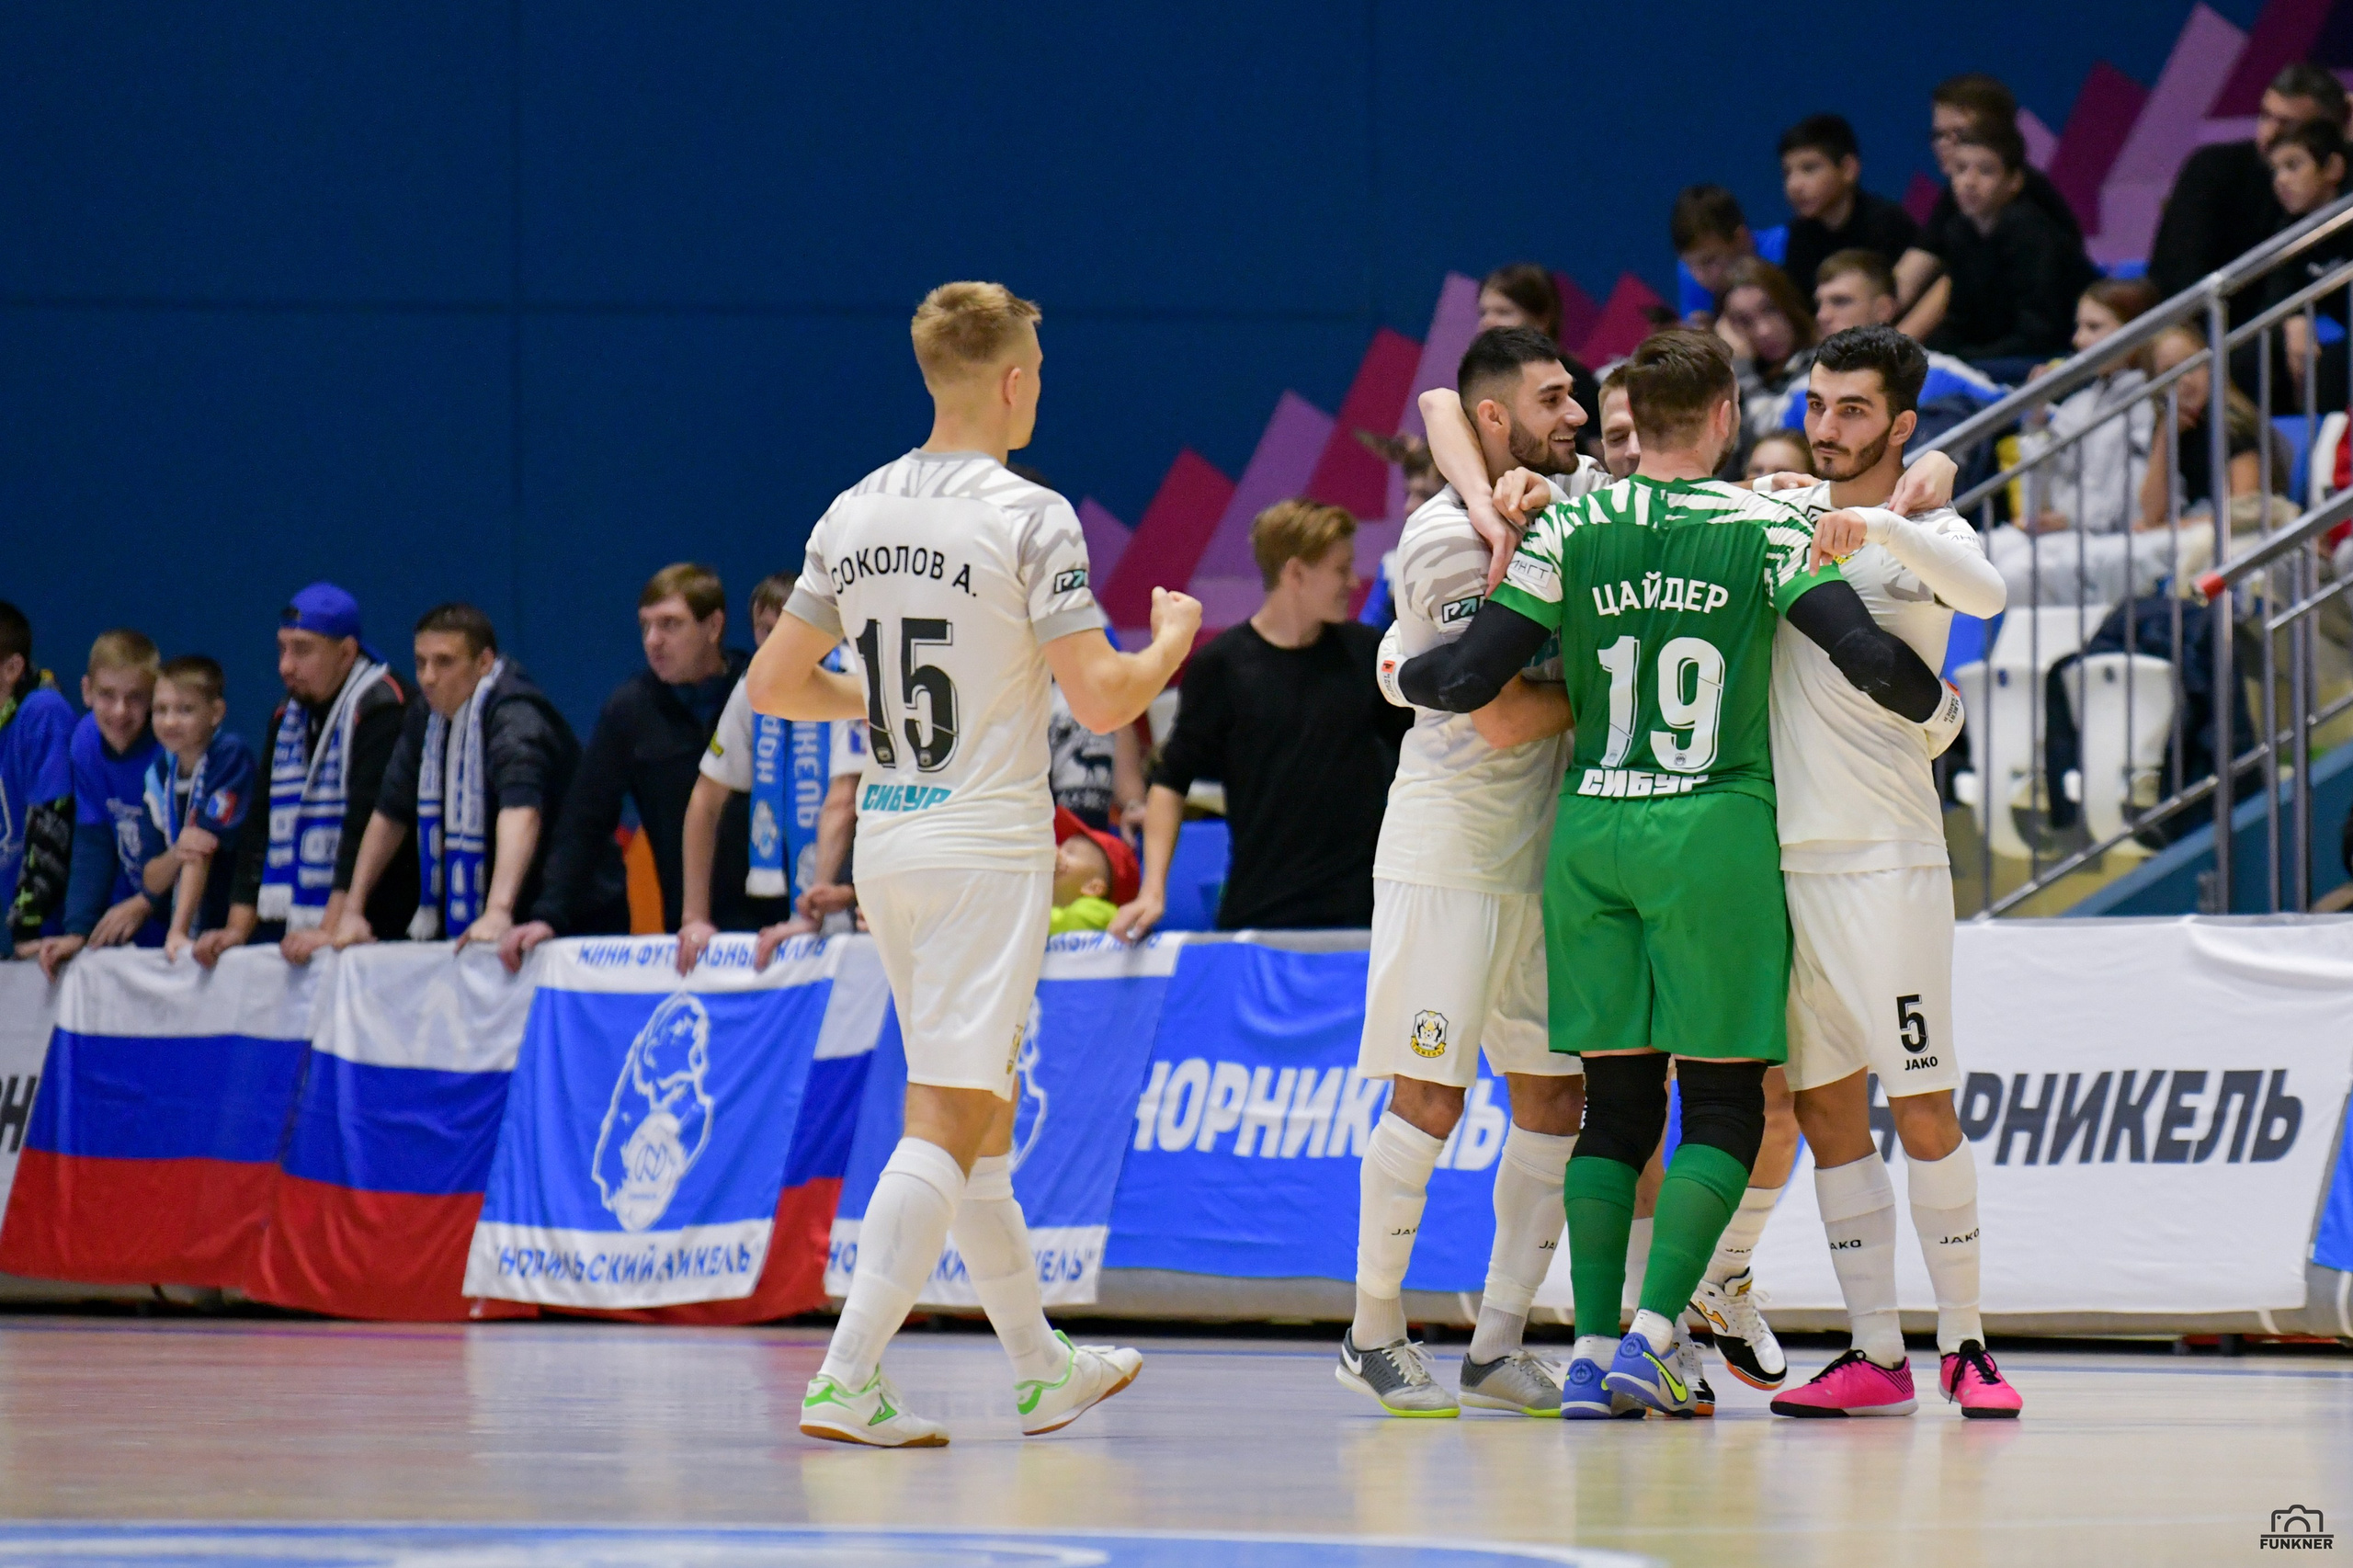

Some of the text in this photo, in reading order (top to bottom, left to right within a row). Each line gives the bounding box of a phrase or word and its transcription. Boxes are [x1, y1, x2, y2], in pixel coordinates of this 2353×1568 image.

[832, 546, 977, 597] СОКОЛОВ А.
[1592, 571, 1729, 616] ЦАЙДЕР
[857, 618, 959, 772] 15
[1597, 635, 1725, 773] 19
[862, 784, 952, 812] СИБУР
[1577, 769, 1709, 798] СИБУР
[1896, 994, 1929, 1054] 5
[1904, 1055, 1938, 1071] JAKO
[1133, 1057, 1507, 1172] НОРНИКЬ
[1867, 1069, 2305, 1166] НРНИКЕЛЬ
[1830, 1239, 1861, 1251] AKO
[1939, 1228, 1980, 1244] JAKO
